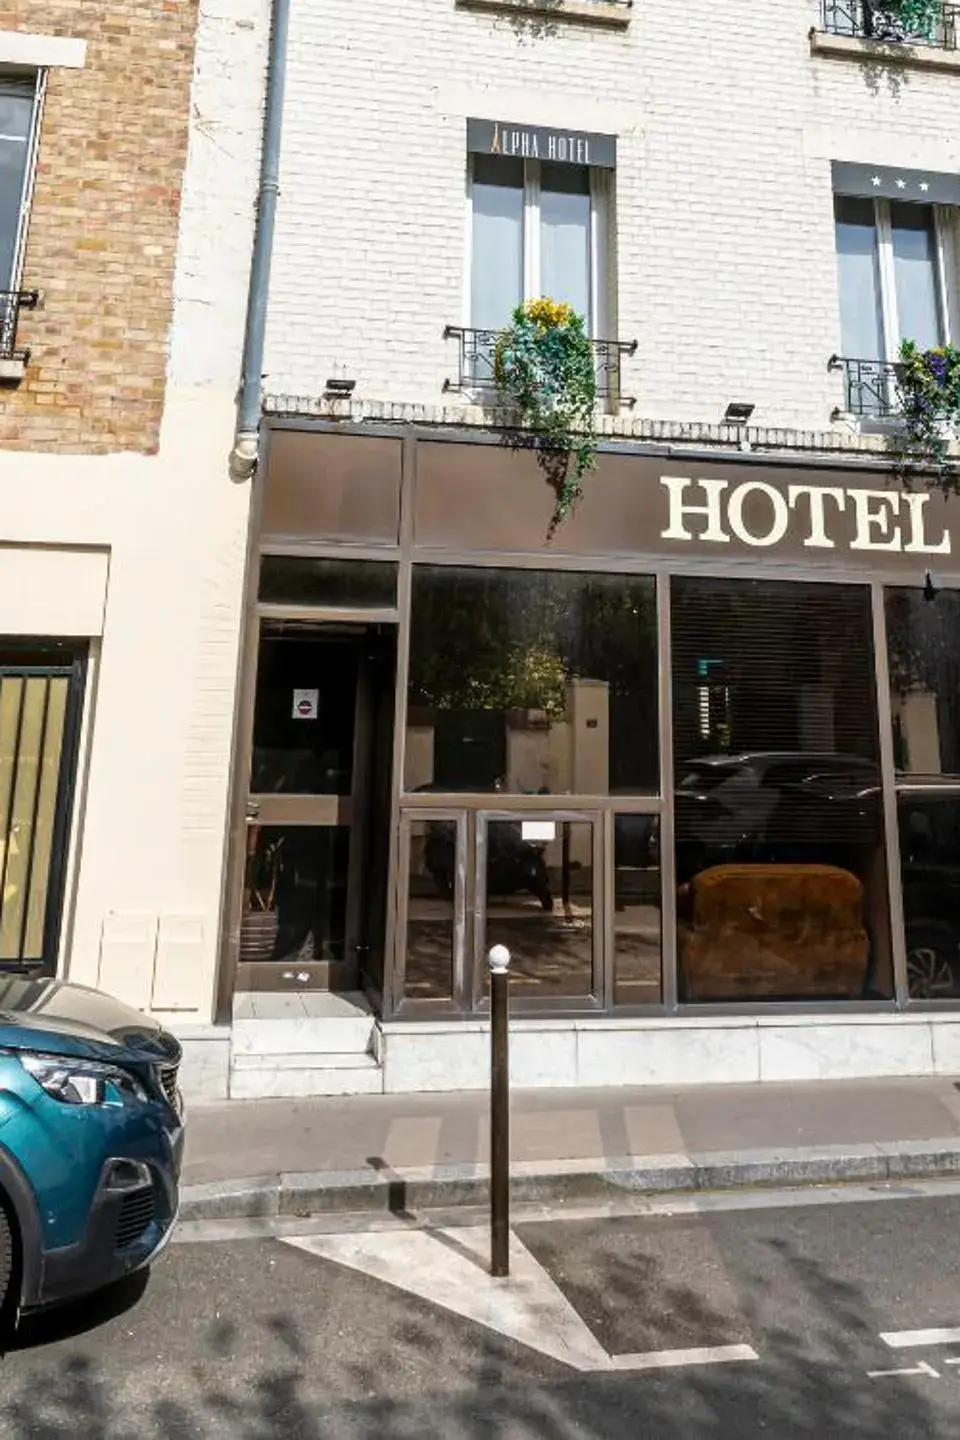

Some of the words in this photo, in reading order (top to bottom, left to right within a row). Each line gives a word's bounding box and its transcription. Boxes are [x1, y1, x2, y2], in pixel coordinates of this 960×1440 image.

[490, 122, 539, 158] ALPHA
[548, 135, 590, 164] HOTEL
[660, 476, 952, 556] HOTEL
